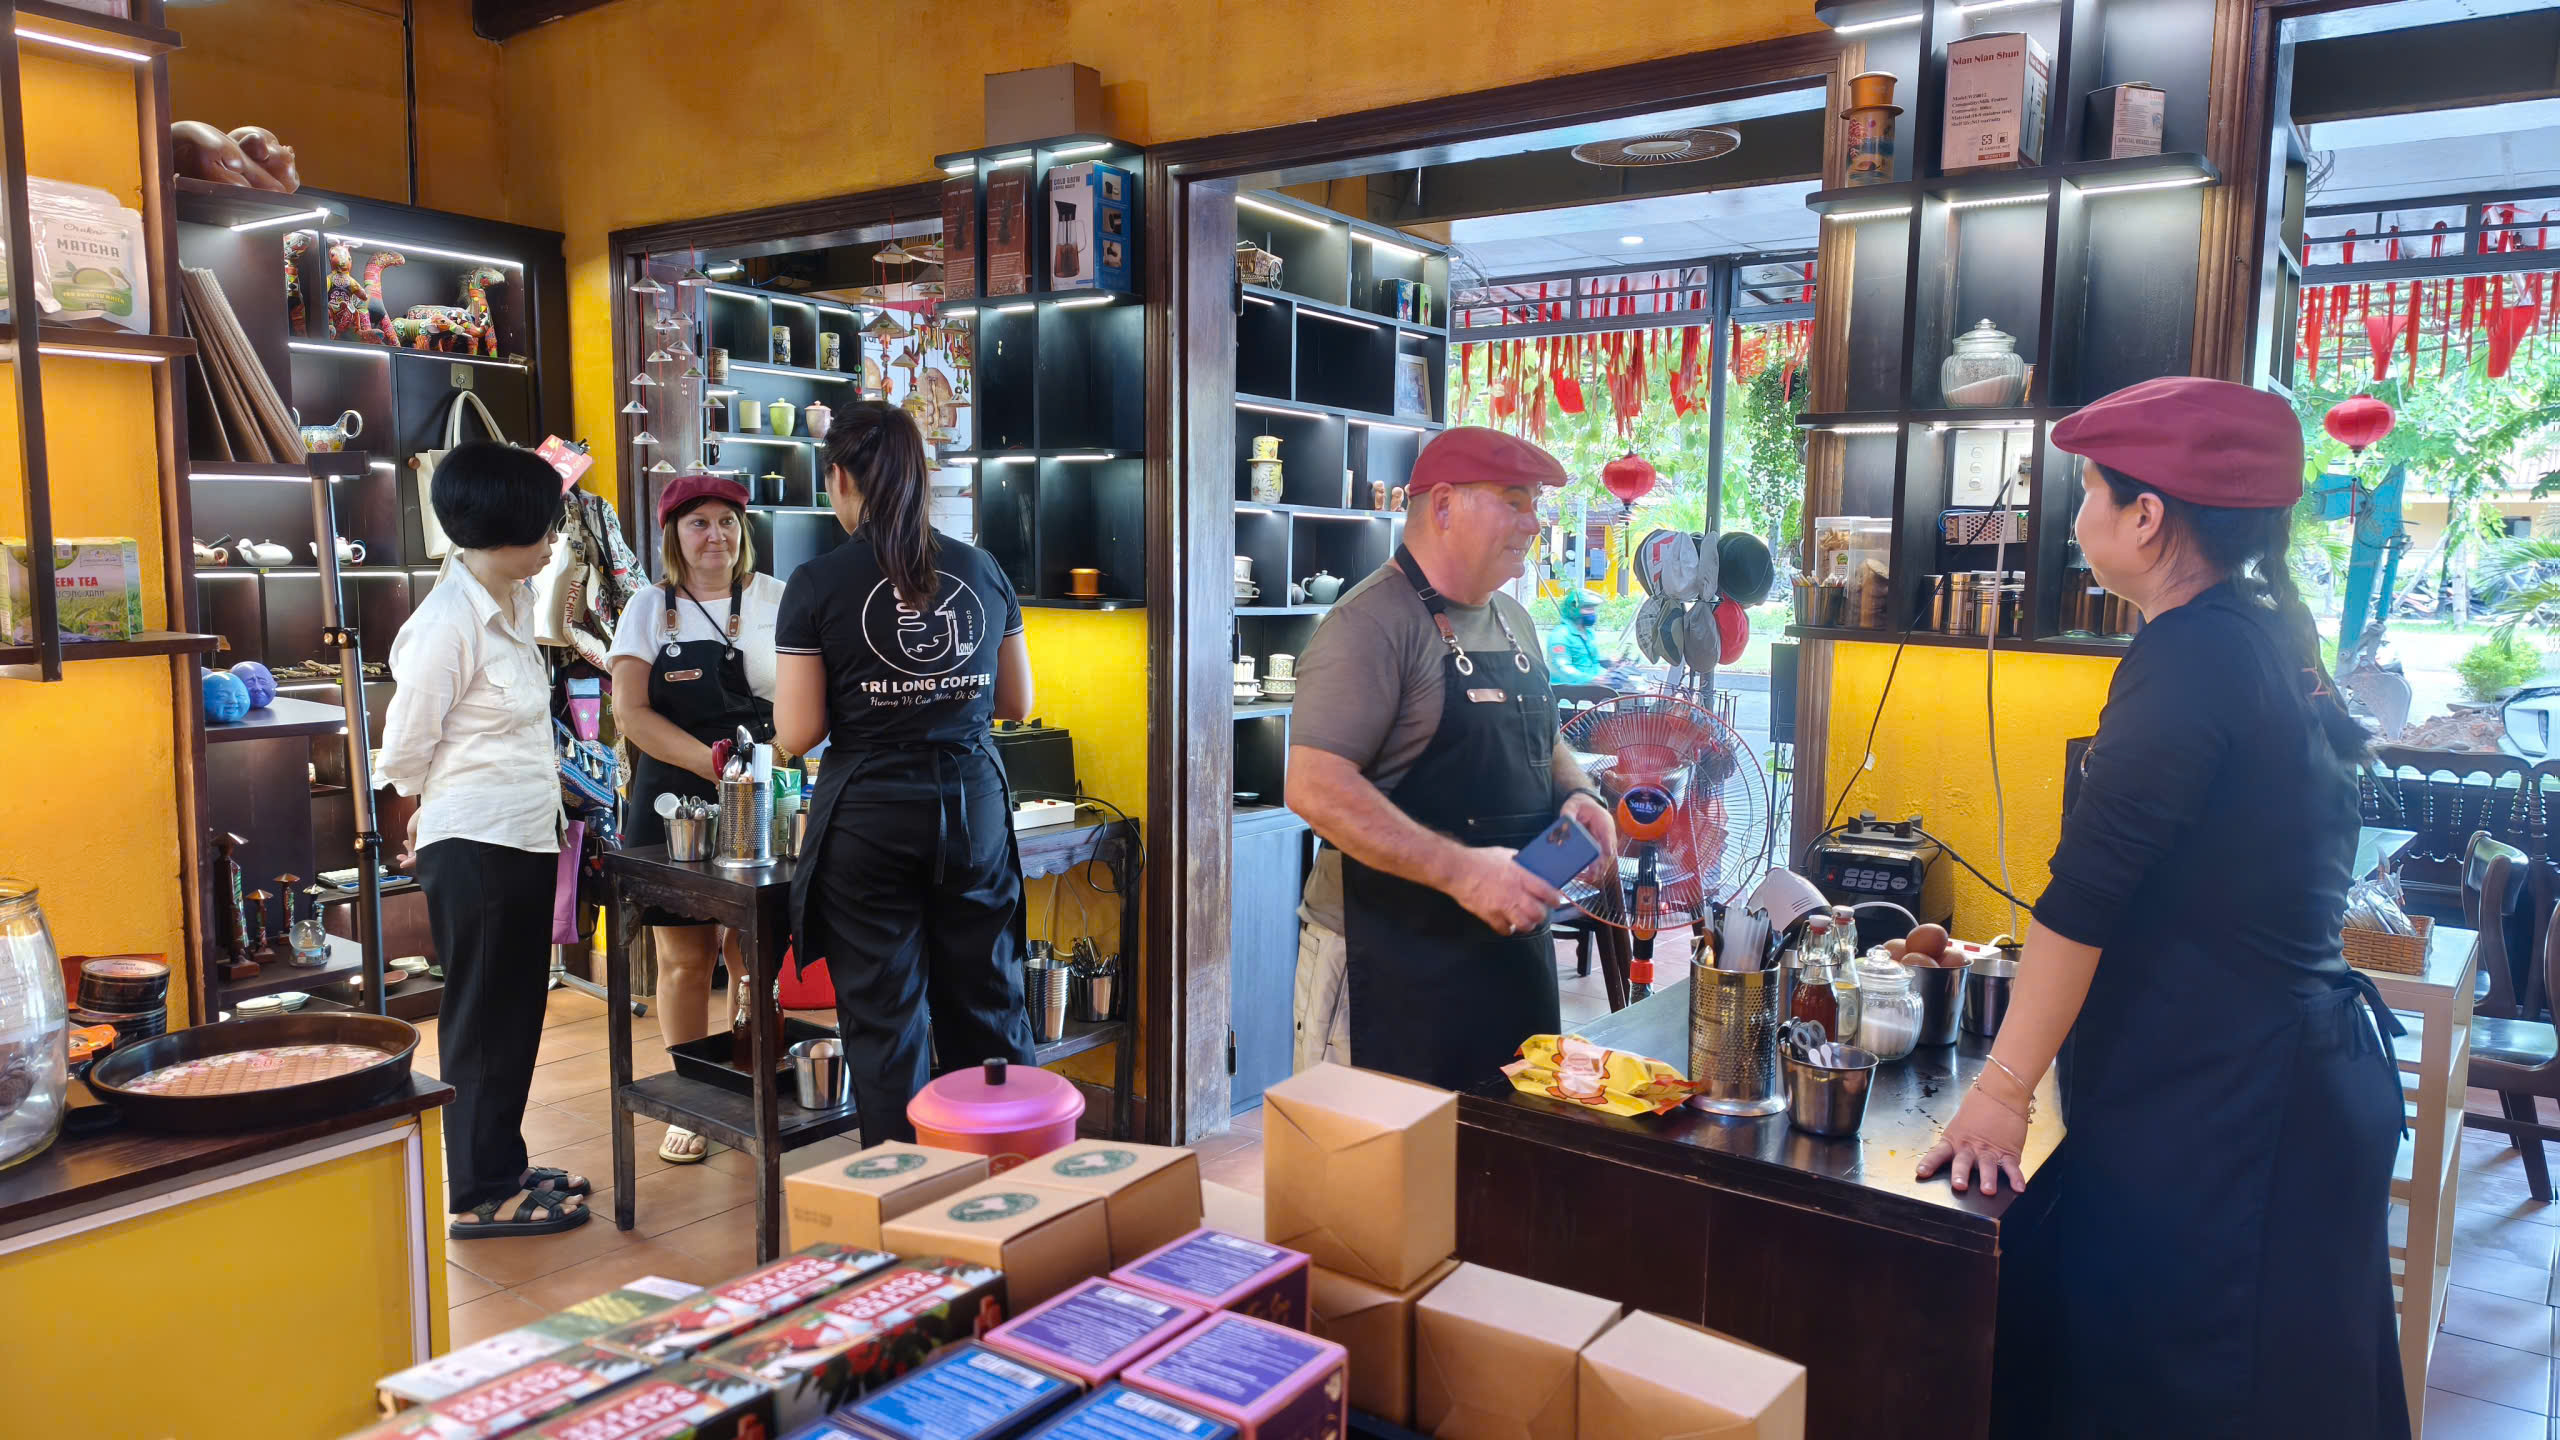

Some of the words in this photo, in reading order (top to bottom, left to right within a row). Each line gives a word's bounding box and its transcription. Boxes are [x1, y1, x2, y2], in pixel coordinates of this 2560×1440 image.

[1952, 57, 1972, 66] Nian
[1974, 54, 1994, 63] Nian
[1996, 50, 2019, 60] Shun
[56, 238, 120, 258] MATCHA
[55, 577, 75, 588] EEN
[78, 576, 99, 588] TEA
[966, 610, 974, 640] COFFEE
[861, 679, 887, 694] TRÍ
[892, 679, 936, 693] LONG
[940, 673, 991, 689] COFFEE
[742, 1261, 837, 1303] SALTED
[852, 1274, 945, 1320] SALTED
